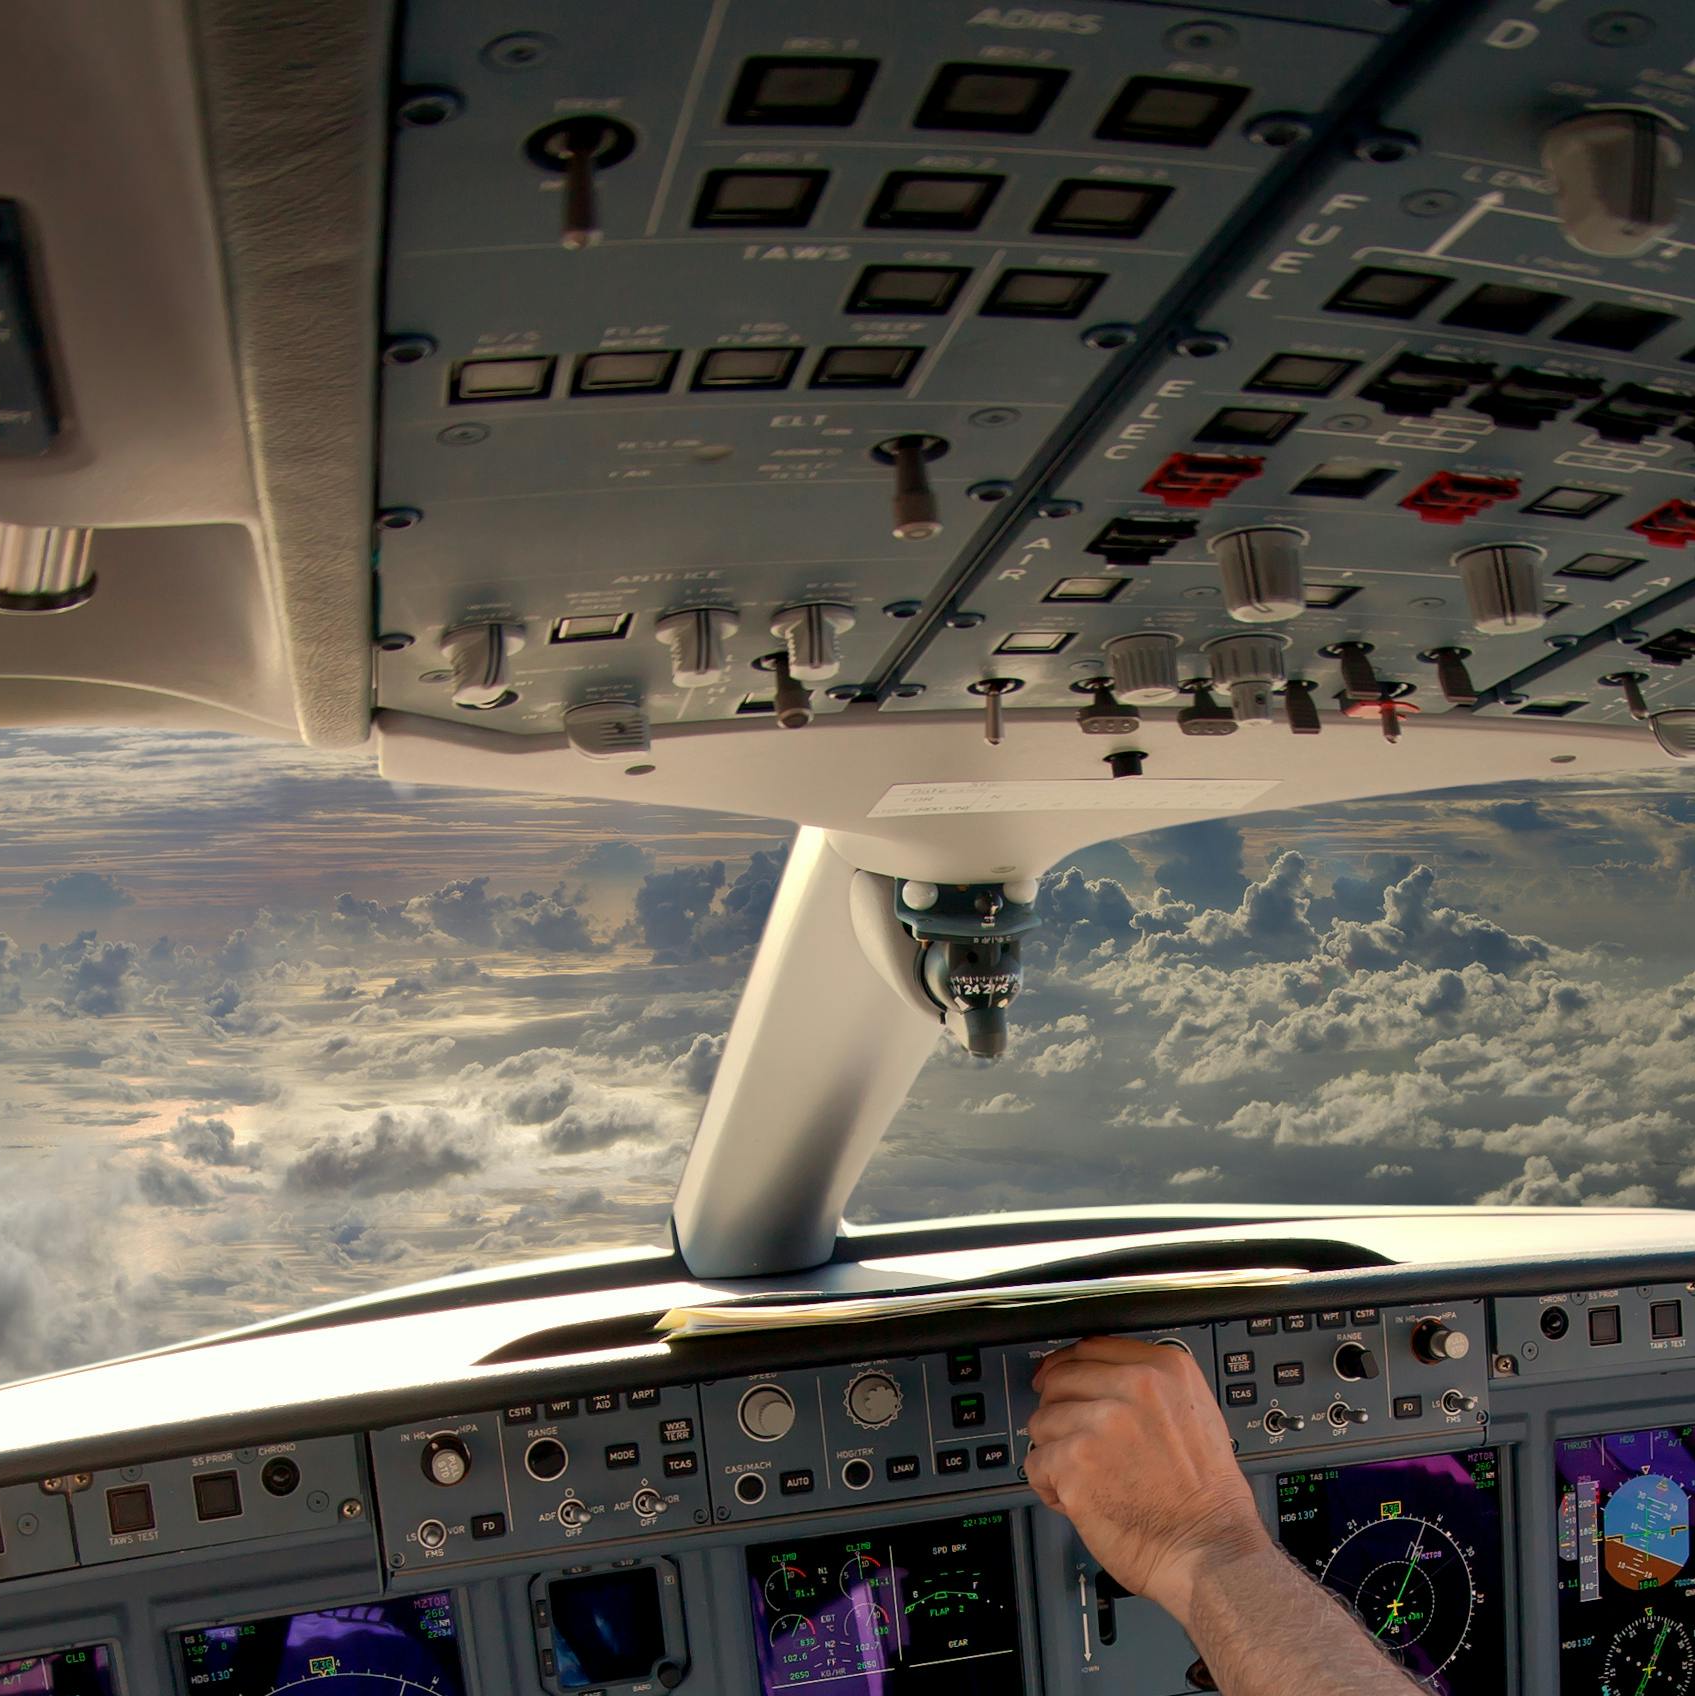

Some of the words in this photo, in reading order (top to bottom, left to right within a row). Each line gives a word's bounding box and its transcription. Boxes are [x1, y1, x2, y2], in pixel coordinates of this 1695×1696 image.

[966, 8, 1104, 35] ADIRS
[744, 245, 852, 261] TAWS
[1539, 1295, 1567, 1304] CHRONO
[1670, 1340, 1686, 1348] TEST
[1278, 1368, 1300, 1378] MODE
[632, 1389, 655, 1400] ARPT
[1231, 1389, 1252, 1399] TCAS
[552, 1401, 571, 1411] WPT
[595, 1400, 611, 1410] AID
[508, 1406, 532, 1418] CSTR
[963, 1411, 977, 1420] A/T
[459, 1424, 478, 1433] HPA
[666, 1421, 687, 1430] WXR
[527, 1427, 558, 1438] RANGE
[665, 1431, 690, 1441] TERR
[258, 1443, 296, 1456] CHRONO
[836, 1447, 874, 1459] HDG/TRK
[192, 1457, 204, 1467] SS
[206, 1452, 234, 1465] PRIOR
[610, 1450, 635, 1461] MODE
[985, 1451, 1003, 1462] APP
[669, 1459, 692, 1470] TCAS
[946, 1456, 962, 1467] LOC
[724, 1460, 772, 1474] CAS/MACH
[892, 1463, 915, 1474] LNAV
[787, 1476, 810, 1487] AUTO
[614, 1502, 631, 1511] ADF
[539, 1512, 556, 1522] ADF
[640, 1517, 657, 1527] OFF
[448, 1525, 465, 1535] VOR
[483, 1521, 495, 1531] FD
[565, 1528, 583, 1537] OFF
[109, 1535, 134, 1546] TAWS
[138, 1532, 159, 1542] TEST
[425, 1549, 445, 1559] FMS
[313, 1660, 332, 1670] 236
